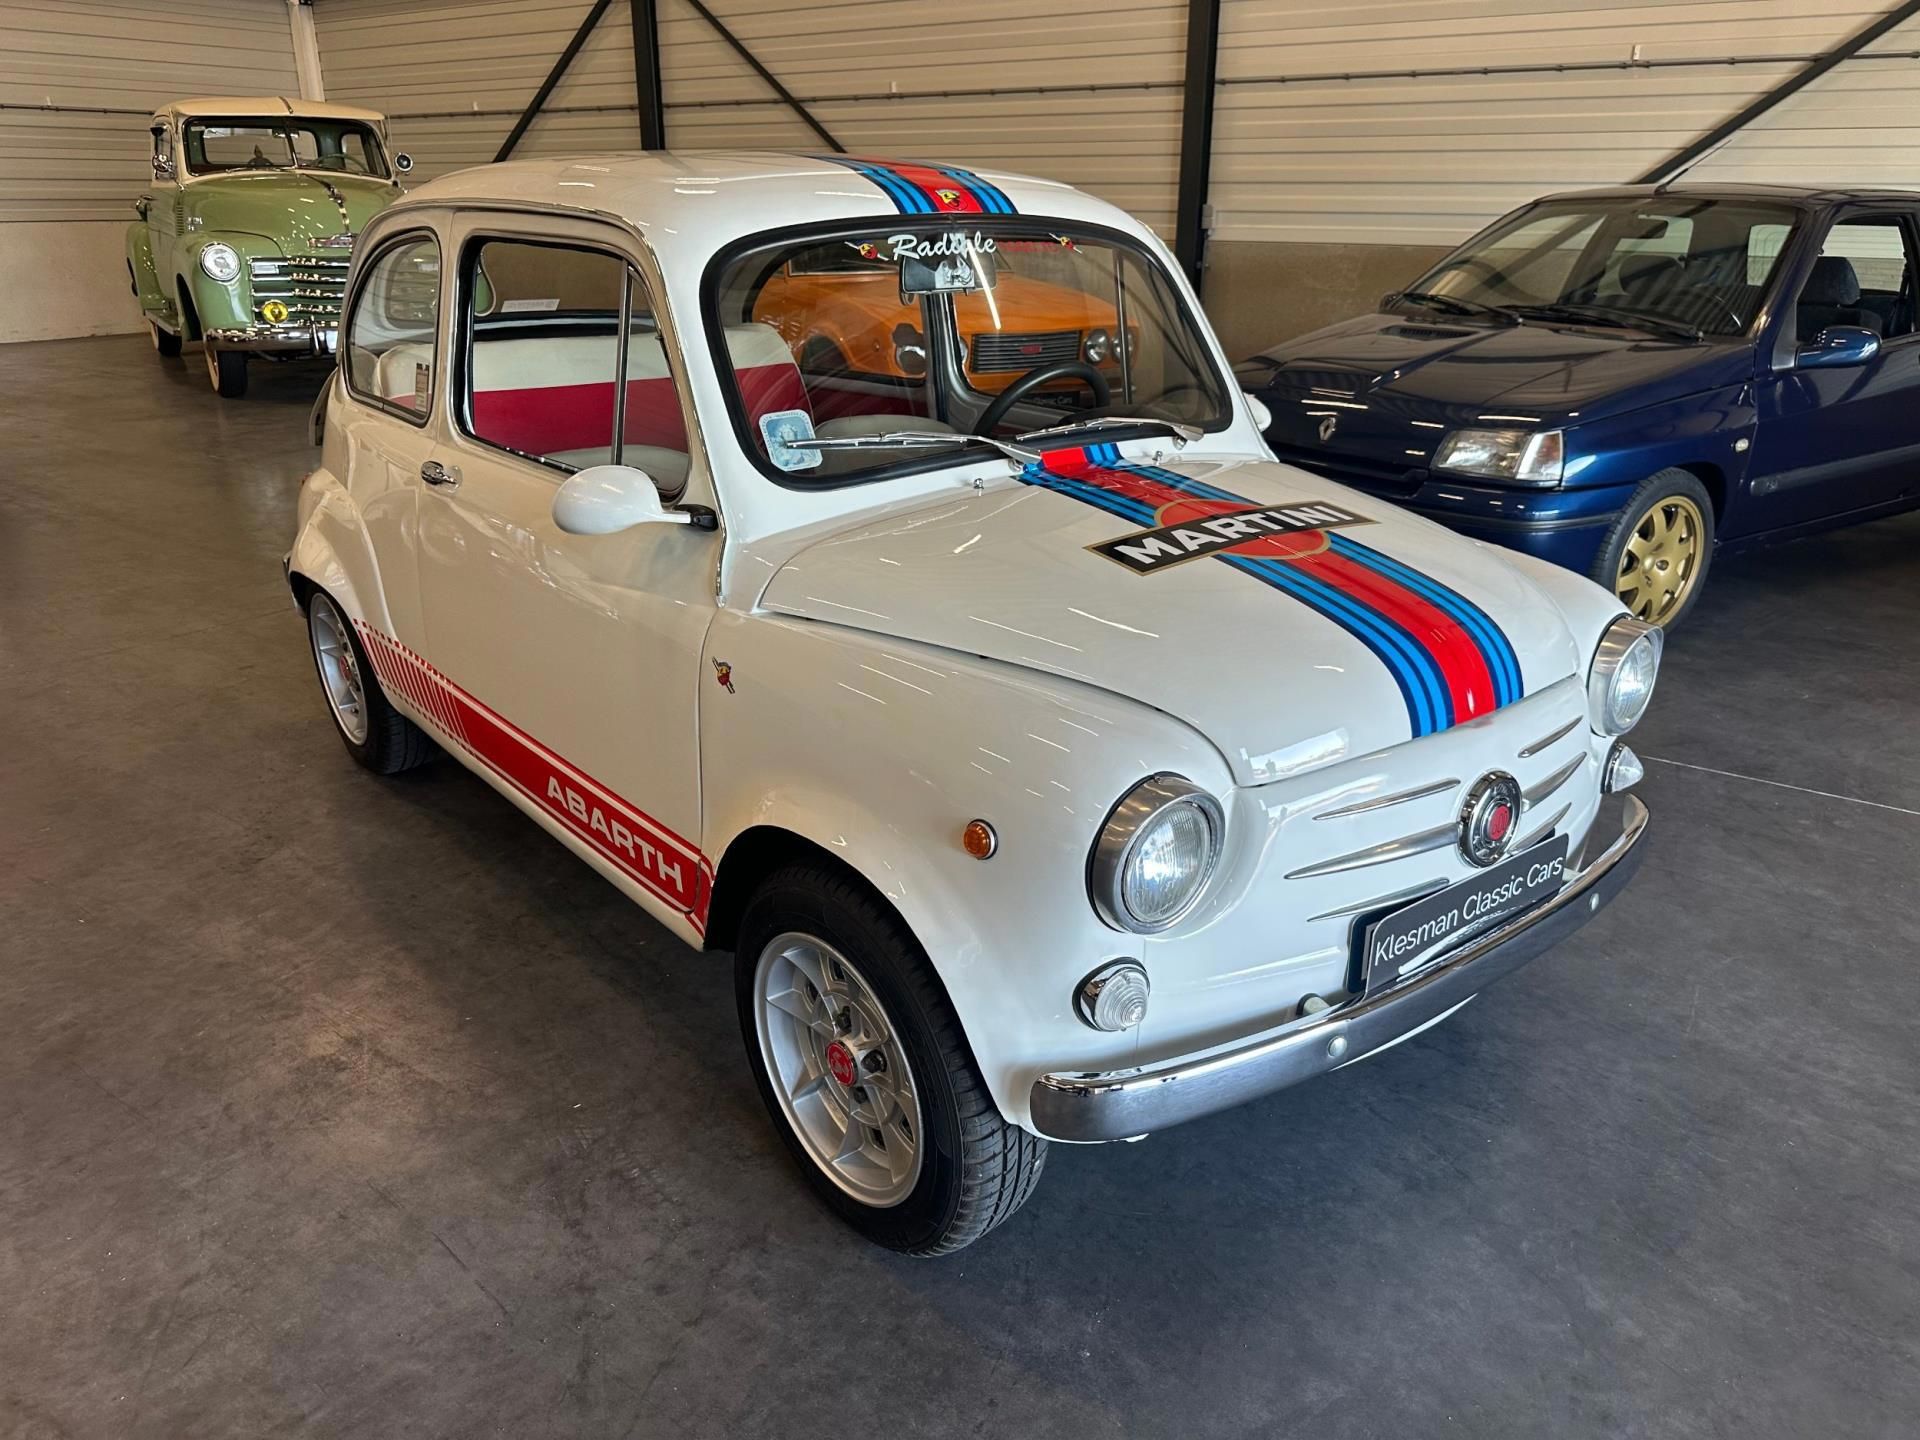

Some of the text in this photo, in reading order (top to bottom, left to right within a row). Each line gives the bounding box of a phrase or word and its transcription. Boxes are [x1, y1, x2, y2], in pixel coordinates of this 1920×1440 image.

[888, 231, 997, 261] Radile
[1114, 505, 1354, 564] MARTINI
[547, 775, 684, 893] ABARTH
[1374, 856, 1564, 967] Klesman Classic Cars
